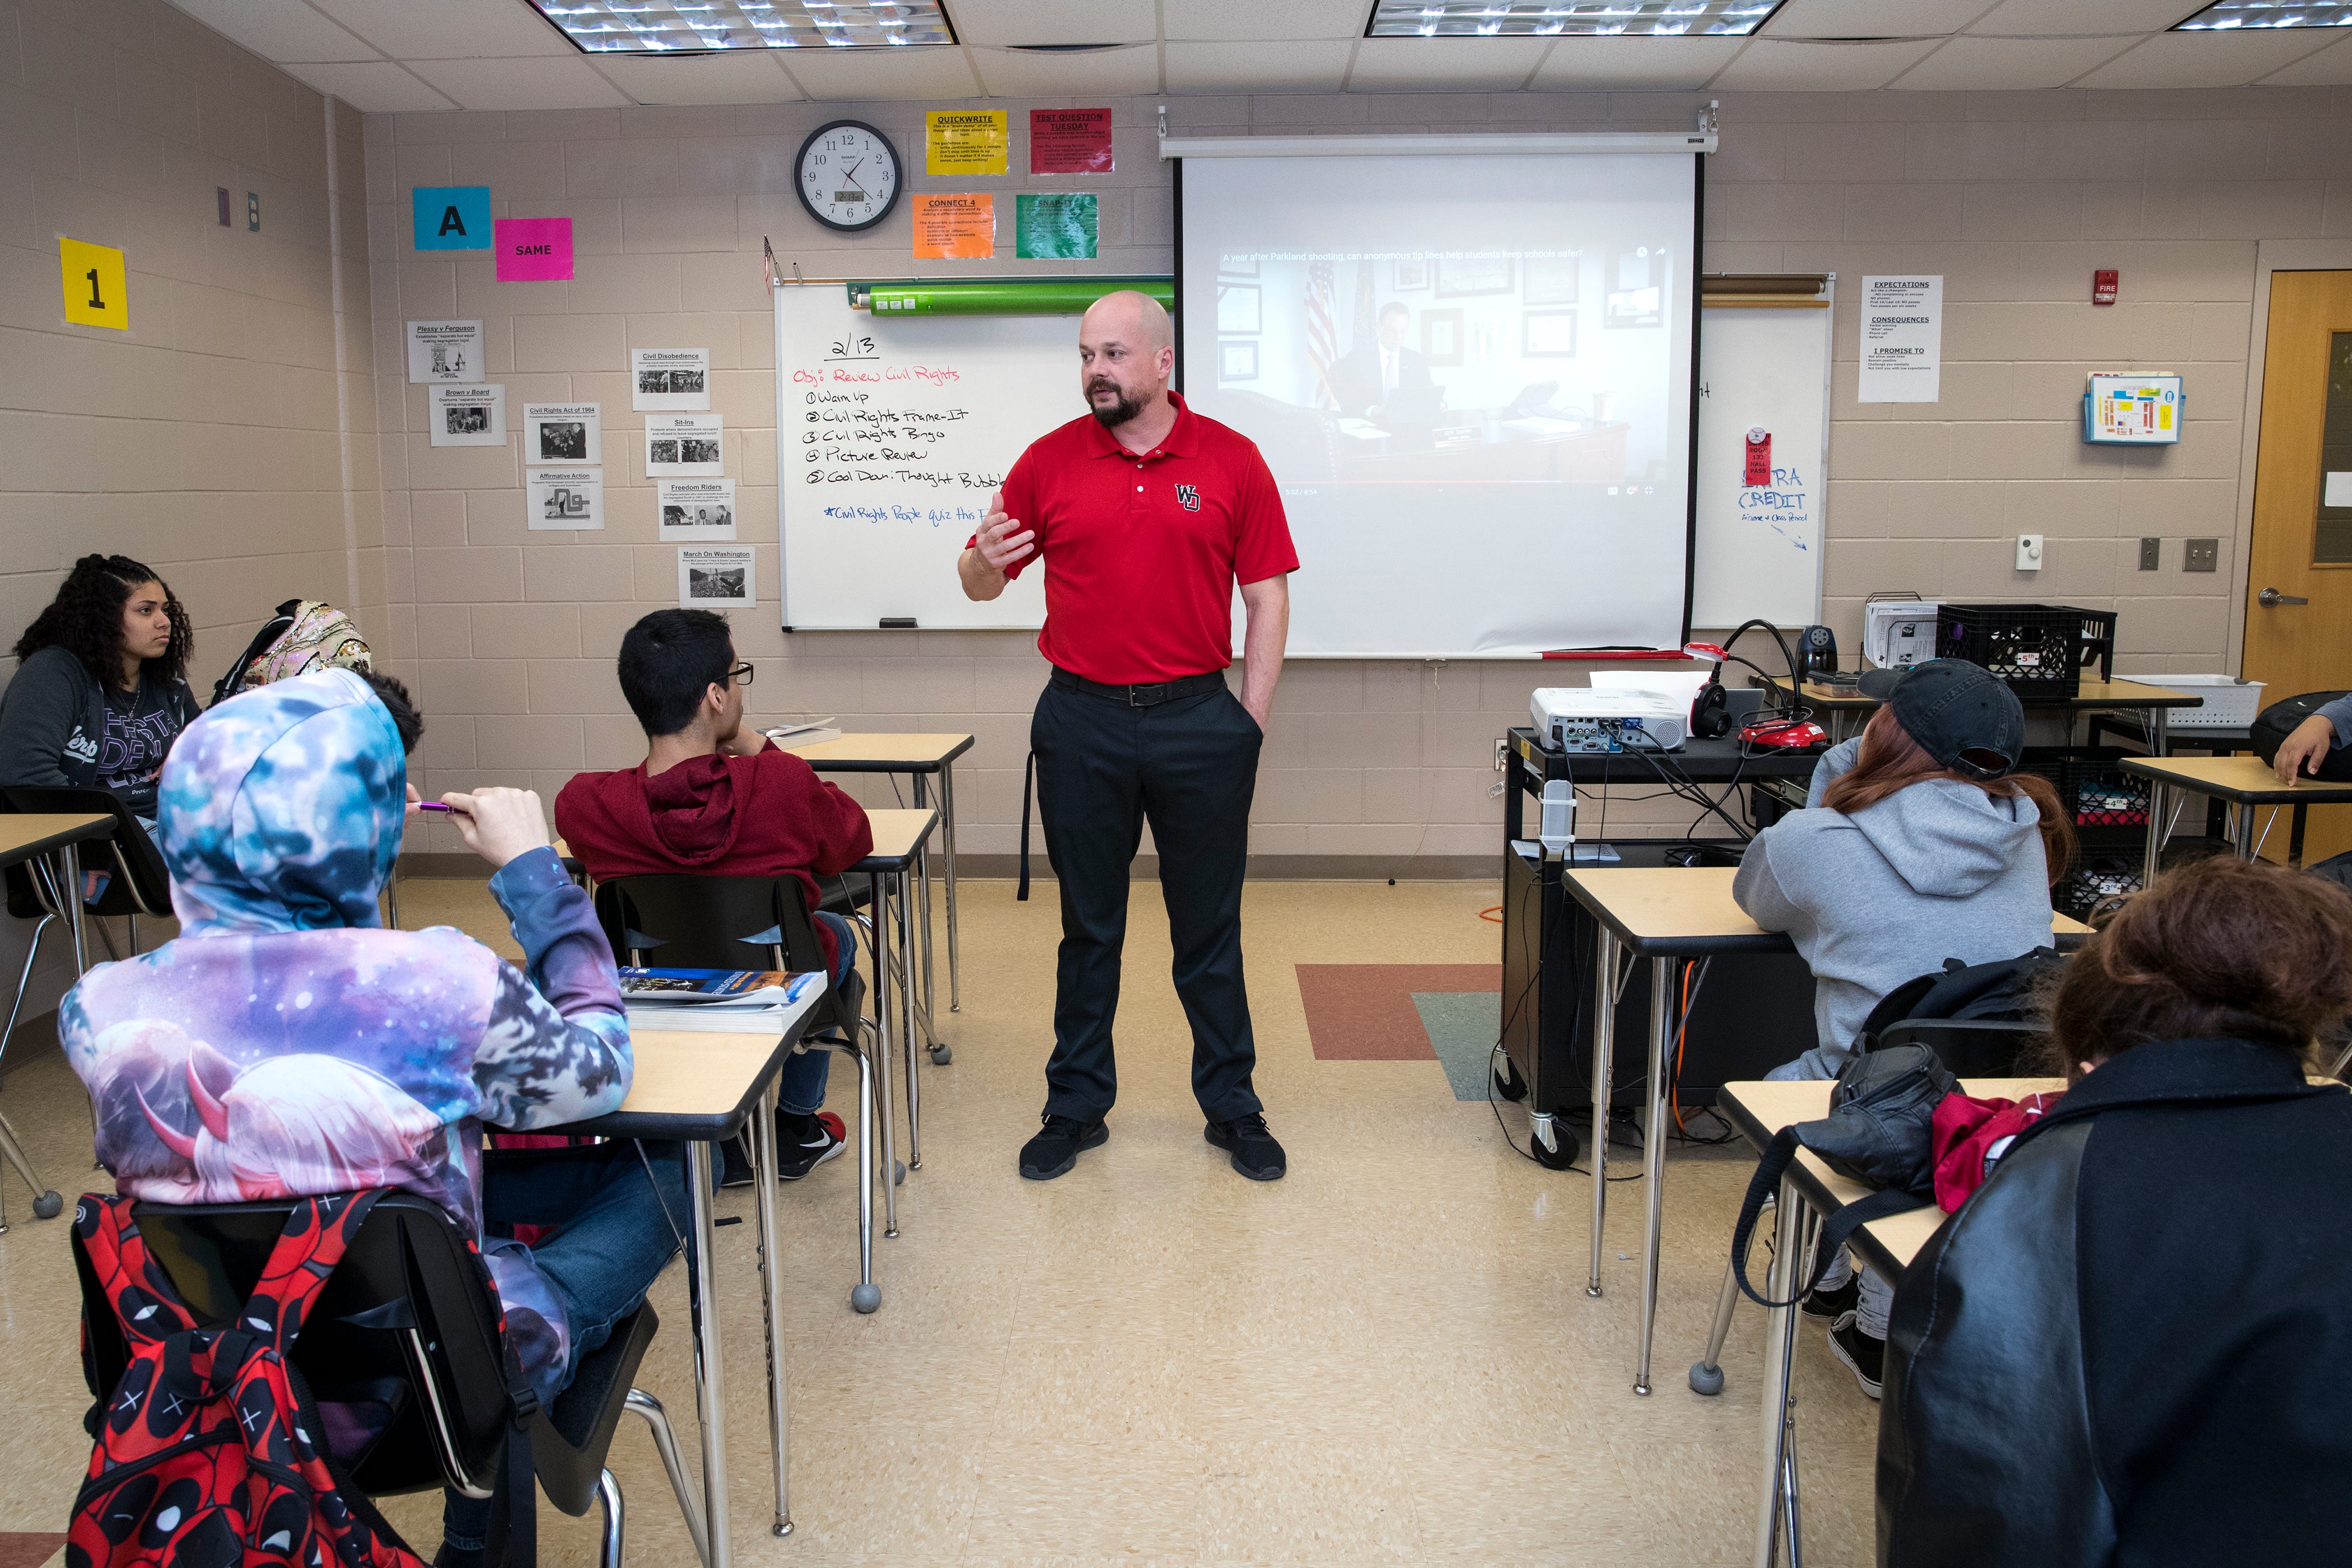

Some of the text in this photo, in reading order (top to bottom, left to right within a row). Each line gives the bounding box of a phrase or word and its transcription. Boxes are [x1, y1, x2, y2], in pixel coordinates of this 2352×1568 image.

[841, 134, 854, 145] 12
[865, 140, 870, 150] 1
[826, 141, 837, 151] 11
[814, 155, 827, 165] 10
[876, 154, 883, 164] 2
[809, 171, 816, 182] 9
[883, 171, 889, 181] 3
[815, 190, 822, 200] 8
[877, 189, 884, 199] 4
[829, 203, 836, 213] 7
[847, 208, 853, 218] 6
[865, 203, 871, 213] 5
[438, 206, 467, 236] A
[516, 245, 551, 255] SAME
[1308, 252, 1345, 262] shooting,
[1364, 253, 1411, 262] anonymous
[1412, 251, 1423, 260] tip
[1425, 251, 1444, 259] lines
[1446, 250, 1463, 260] help
[1465, 250, 1501, 259] students
[1502, 250, 1522, 259] keep
[1524, 250, 1556, 258] schools
[1557, 249, 1583, 258] safer?
[86, 268, 105, 309] 1
[832, 332, 875, 357] 2/13
[793, 366, 960, 388] Obj: Review Civil Rights
[818, 390, 850, 403] Warm
[853, 391, 869, 405] Up
[823, 409, 850, 423] Civil
[851, 409, 900, 428] Rights
[902, 408, 969, 422] Frame-It
[823, 430, 850, 441] Civil
[853, 427, 897, 442] Rights
[902, 427, 945, 442] Bingo
[824, 446, 879, 462] Picture
[880, 448, 928, 461] Review
[827, 471, 853, 482] Cool
[895, 470, 954, 488] Thought
[1738, 491, 1805, 510] CREDIT
[835, 506, 856, 519] Civil
[857, 507, 888, 524] Rights
[891, 505, 922, 524] People
[928, 508, 952, 527] quiz
[956, 507, 975, 520] this
[1788, 512, 1807, 522] Period
[2110, 799, 2123, 807] 4th
